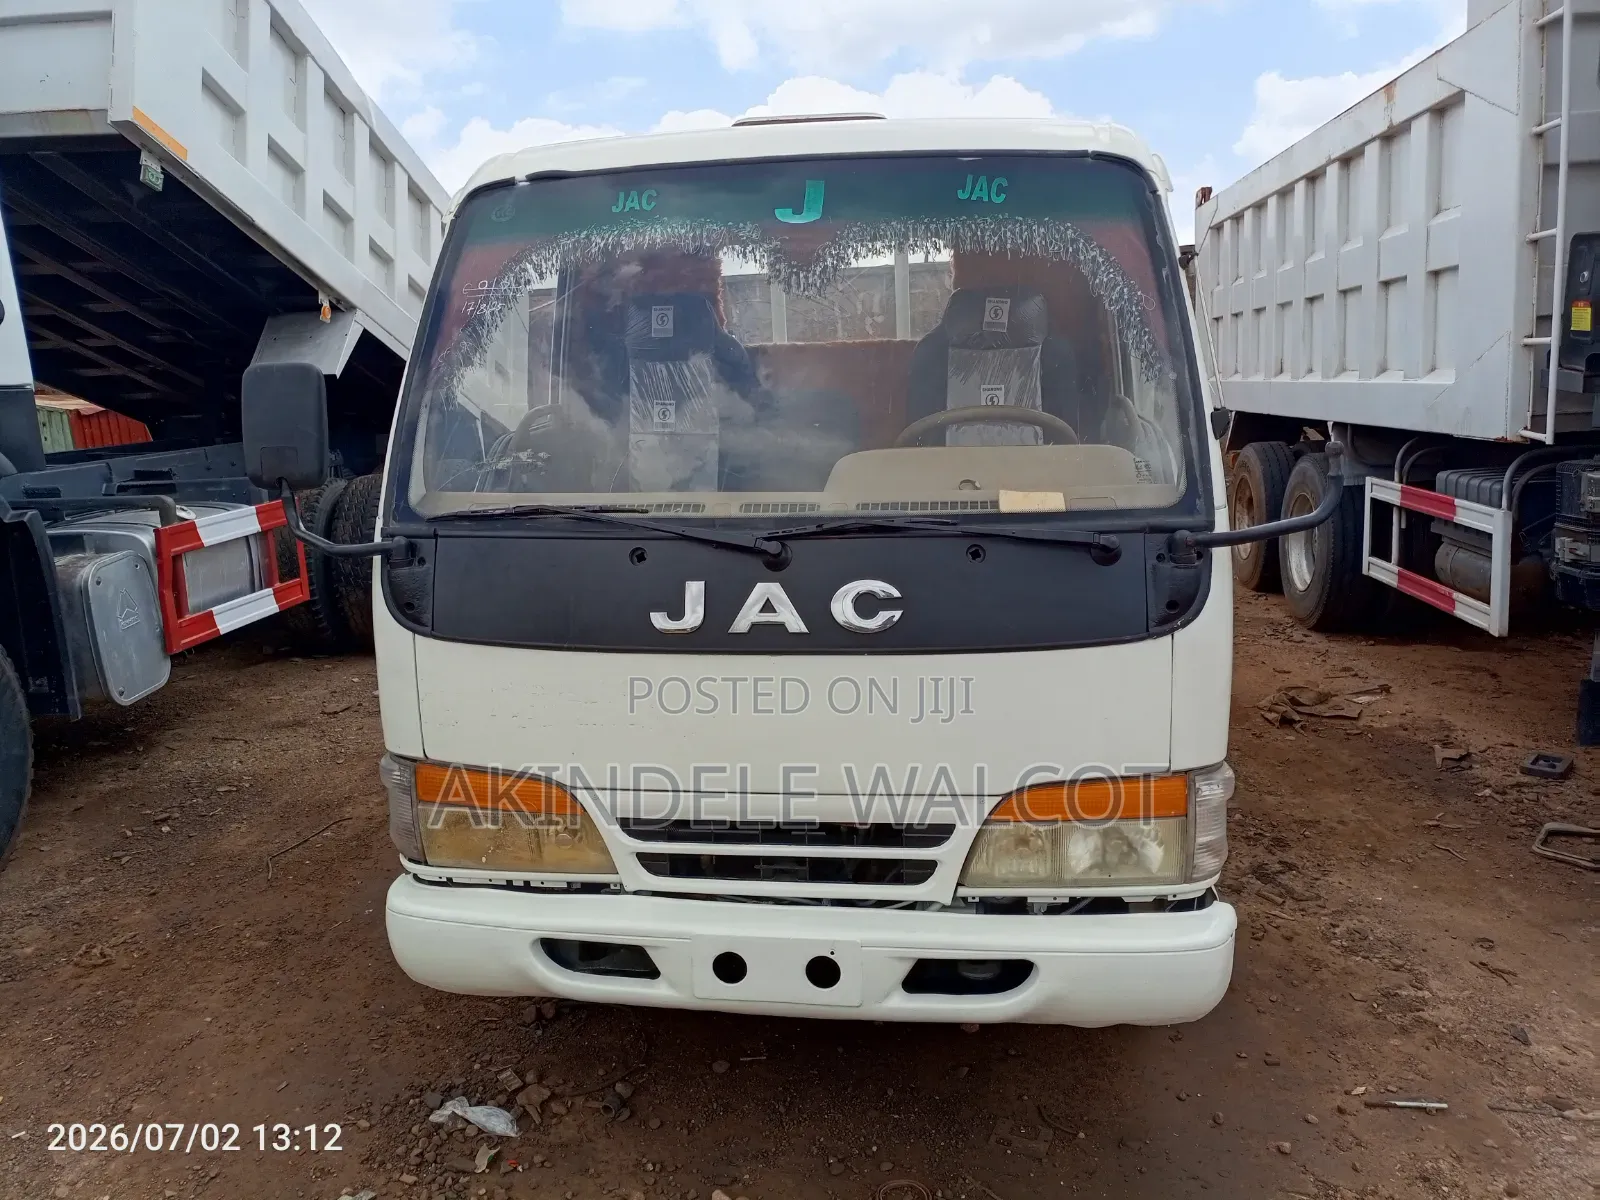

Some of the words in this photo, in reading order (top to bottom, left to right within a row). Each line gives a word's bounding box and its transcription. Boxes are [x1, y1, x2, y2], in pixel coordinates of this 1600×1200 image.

[611, 189, 658, 213] JAC
[774, 180, 825, 224] J
[957, 174, 1008, 204] JAC
[649, 579, 904, 634] JAC
